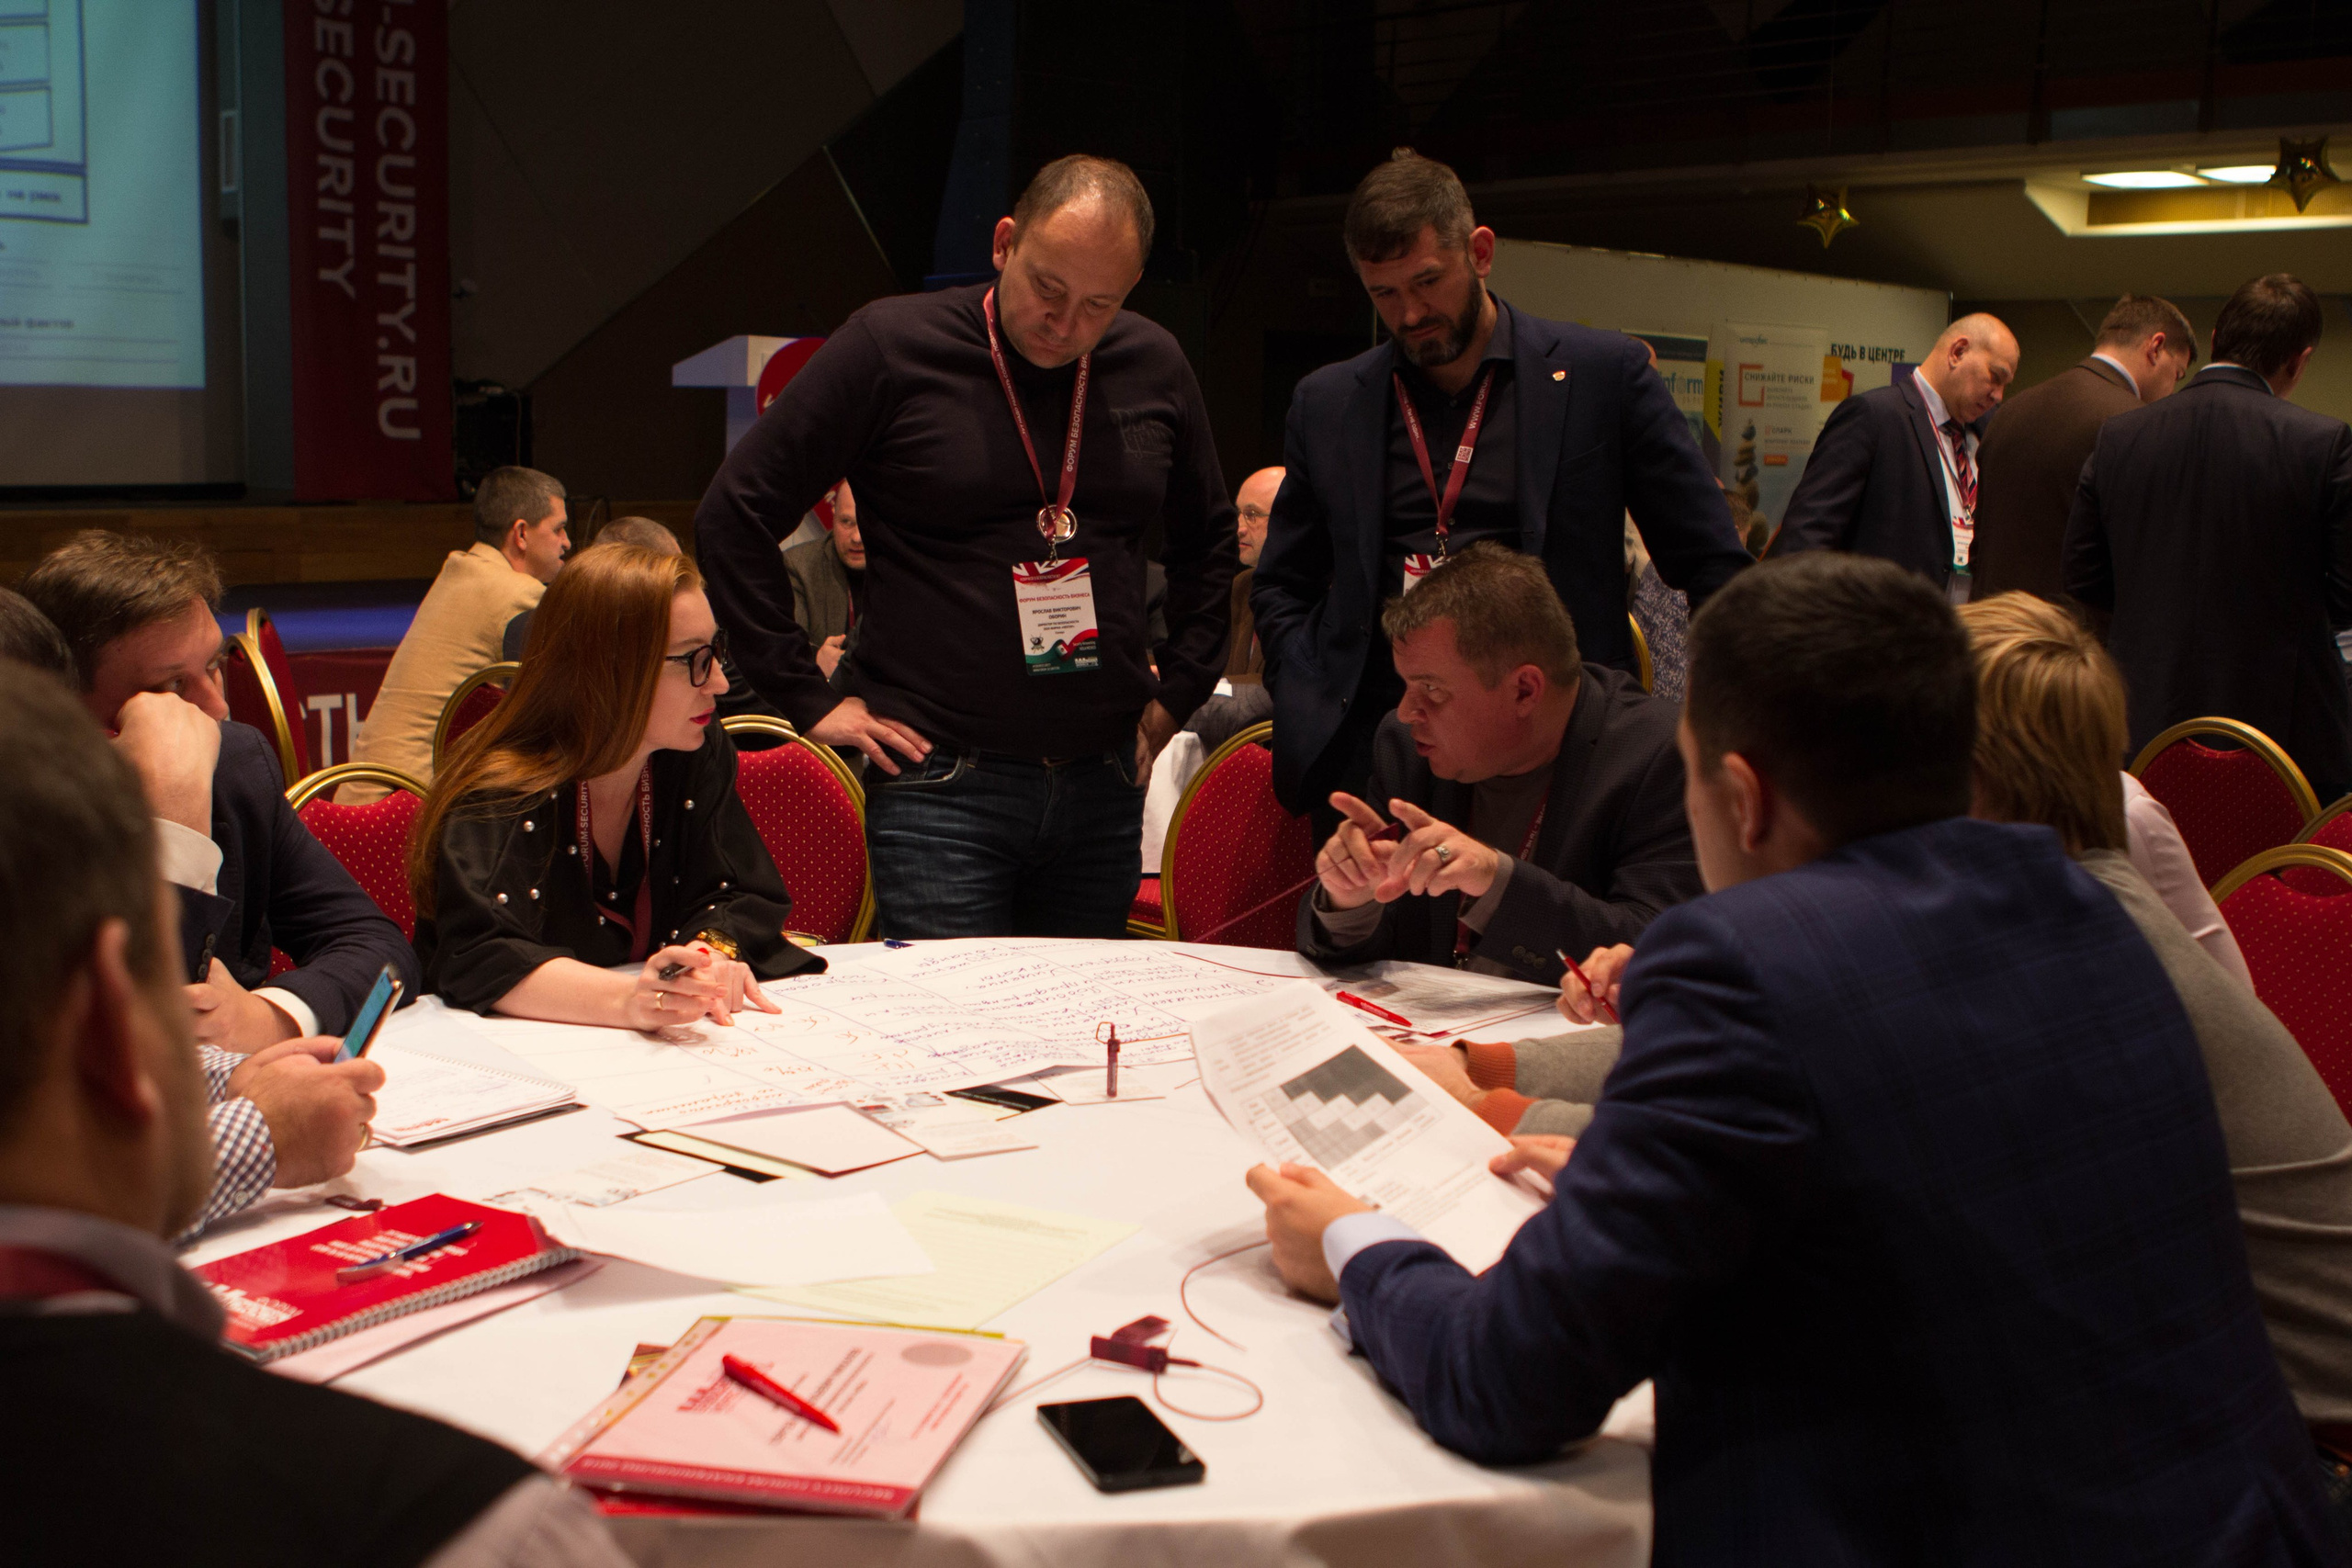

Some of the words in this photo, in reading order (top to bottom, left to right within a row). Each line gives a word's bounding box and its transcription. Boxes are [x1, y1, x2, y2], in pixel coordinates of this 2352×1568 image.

[375, 0, 422, 441] -SECURITY.RU
[1831, 344, 1857, 360] БУДЬ
[1860, 346, 1866, 359] В
[1868, 347, 1905, 365] ЦЕНТРЕ
[1744, 371, 1787, 384] СНИЖАЙТЕ
[1788, 374, 1815, 385] РИСКИ
[1070, 370, 1087, 438] БЕЗОПАСНОСТЬ
[1066, 440, 1078, 472] ФОРУМ
